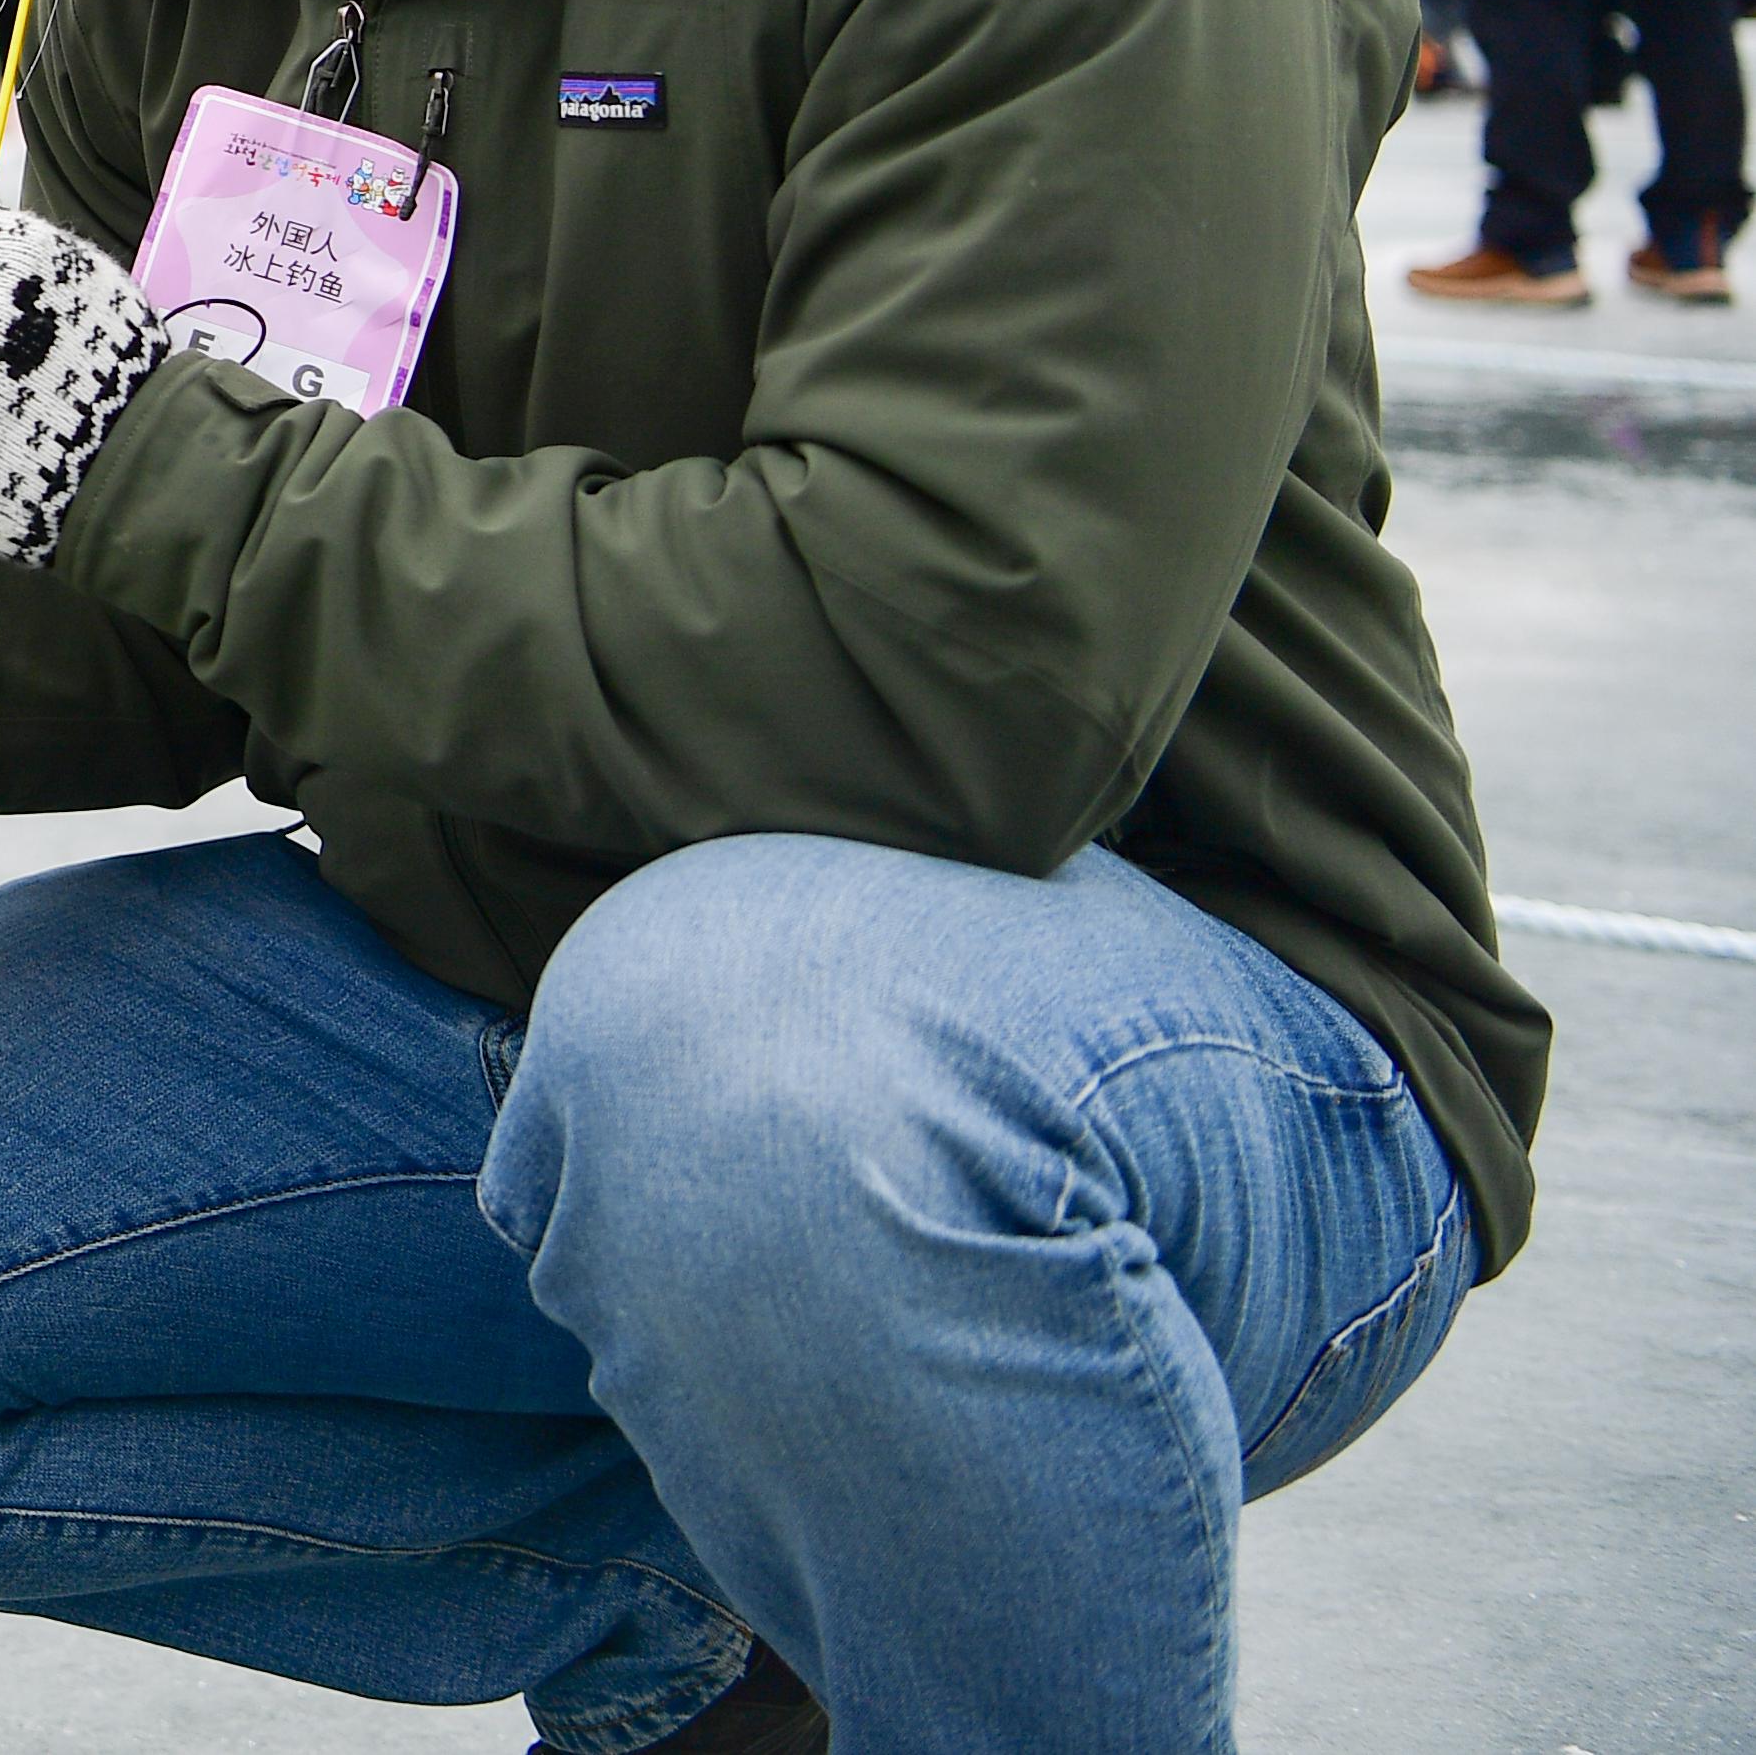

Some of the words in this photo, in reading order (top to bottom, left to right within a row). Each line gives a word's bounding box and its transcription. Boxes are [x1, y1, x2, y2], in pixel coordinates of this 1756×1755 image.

[560, 101, 645, 122] patagonia
[249, 210, 338, 263] 外国人
[223, 243, 343, 304] 冰上钓鱼
[292, 363, 325, 398] G
